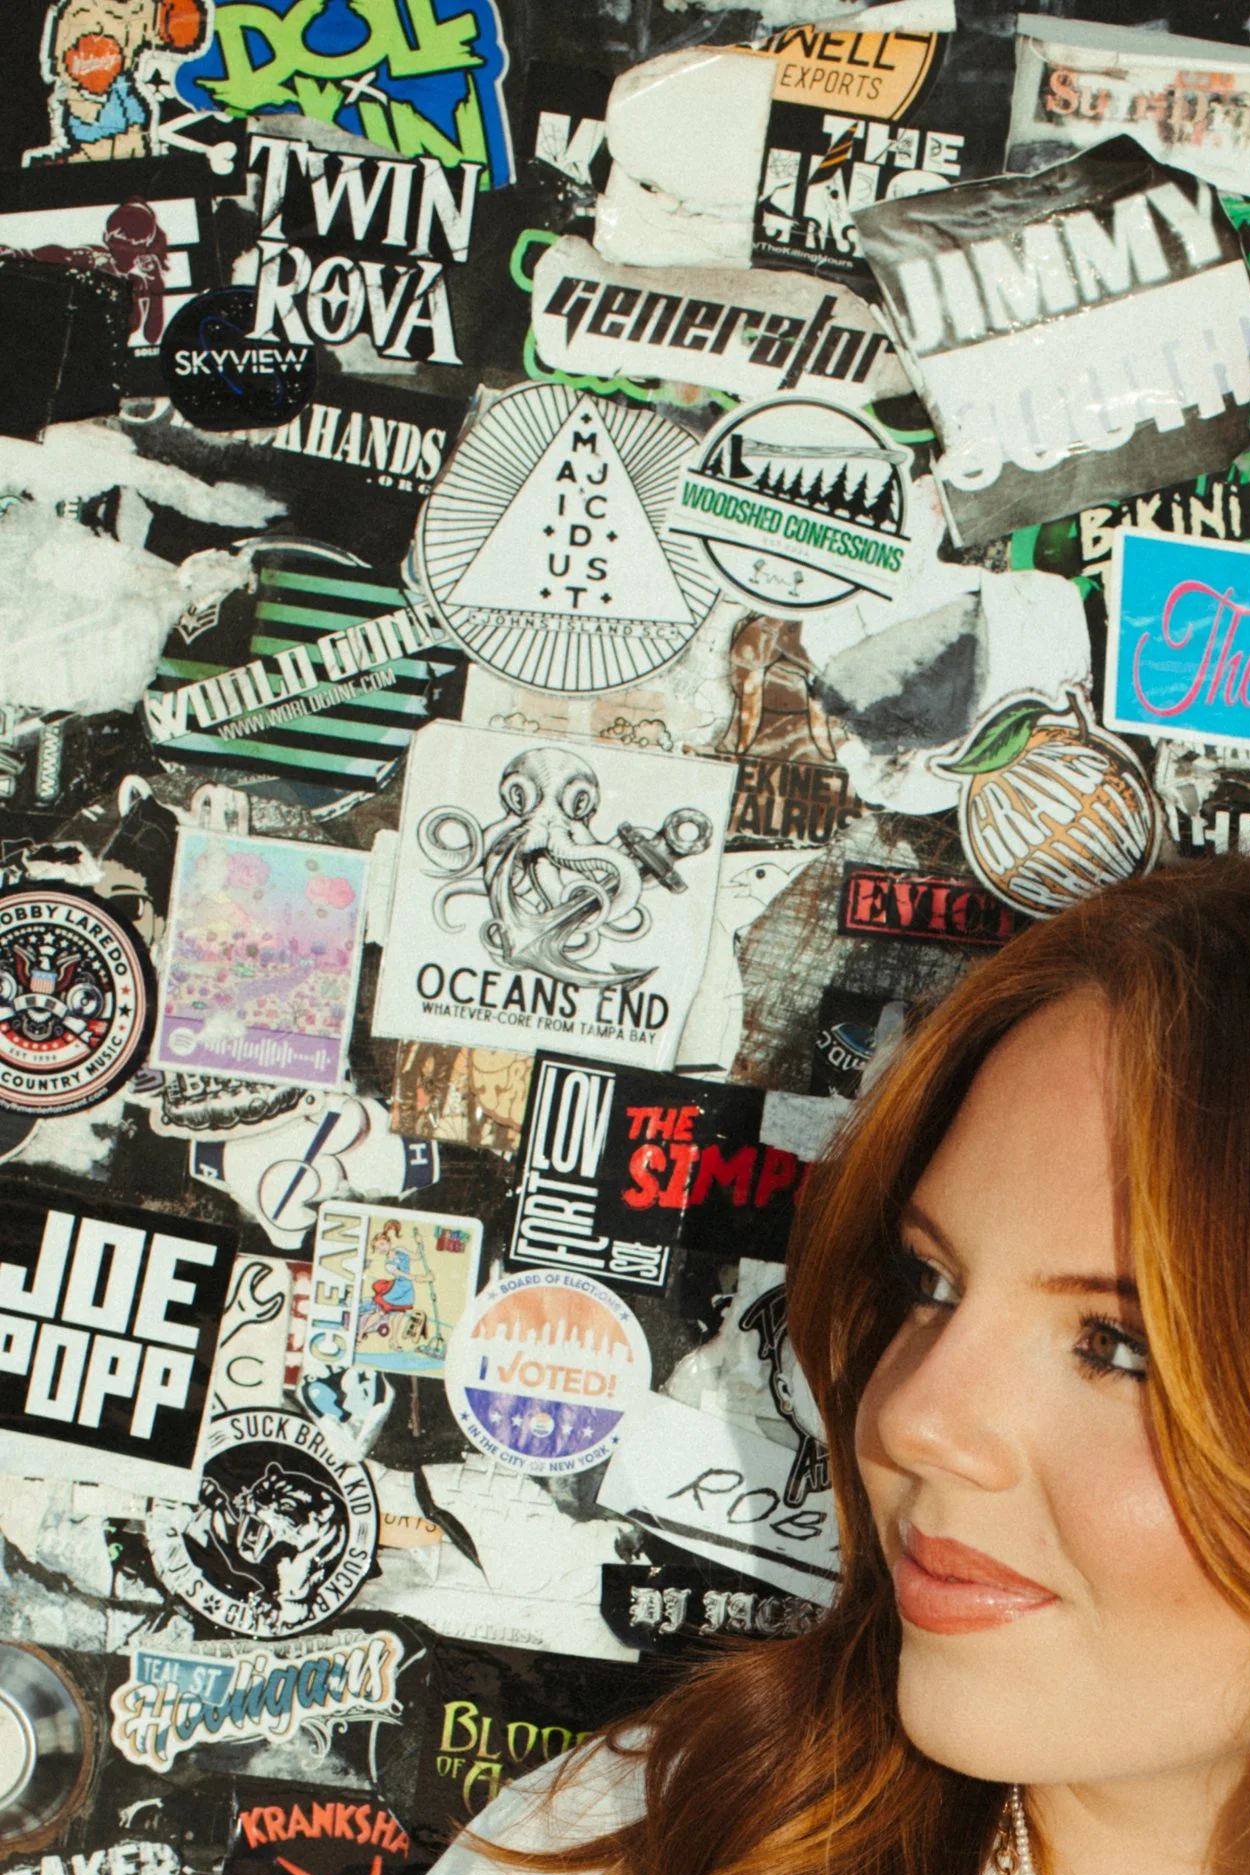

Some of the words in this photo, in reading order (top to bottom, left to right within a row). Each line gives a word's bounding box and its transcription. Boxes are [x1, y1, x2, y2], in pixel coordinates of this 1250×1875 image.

[780, 62, 884, 101] EXPORTS
[822, 113, 966, 177] THE
[248, 135, 484, 263] TWIN
[245, 237, 464, 365] ROVA
[174, 347, 309, 377] SKYVIEW
[680, 480, 784, 534] WOODSHED
[784, 514, 905, 573] CONFESSIONS
[481, 612, 550, 630] JOHNS
[557, 617, 634, 636] ISLAND
[643, 626, 666, 638] SC
[150, 642, 318, 744] WORLD
[64, 908, 128, 977] LAREDO
[851, 882, 1014, 942] EVIC
[415, 963, 582, 1020] OCEANS
[596, 983, 670, 1031] END
[422, 1000, 533, 1029] WHATEVER-CORE
[536, 1016, 575, 1034] FROM
[579, 1021, 625, 1041] TAMPA
[629, 1029, 657, 1045] BAY
[0, 1070, 82, 1091] COUNTRY
[86, 1035, 123, 1076] MUSIC
[626, 1105, 701, 1142] THE
[621, 1143, 810, 1212] SIMP
[0, 1208, 218, 1350] JOE
[309, 1211, 363, 1364] CLEAN
[499, 1275, 542, 1294] BOARD
[545, 1274, 561, 1285] OF
[230, 1414, 290, 1442] SUCK
[344, 1479, 372, 1517] KID
[467, 1423, 480, 1439] IN
[479, 1433, 501, 1456] THE
[499, 1450, 526, 1469] CITY
[549, 1459, 575, 1473] NEW
[579, 1444, 609, 1467] YORK
[325, 1547, 368, 1599] SUCK
[120, 1638, 394, 1761] Hooligans
[189, 1666, 222, 1696] ST
[435, 1755, 466, 1779] OF
